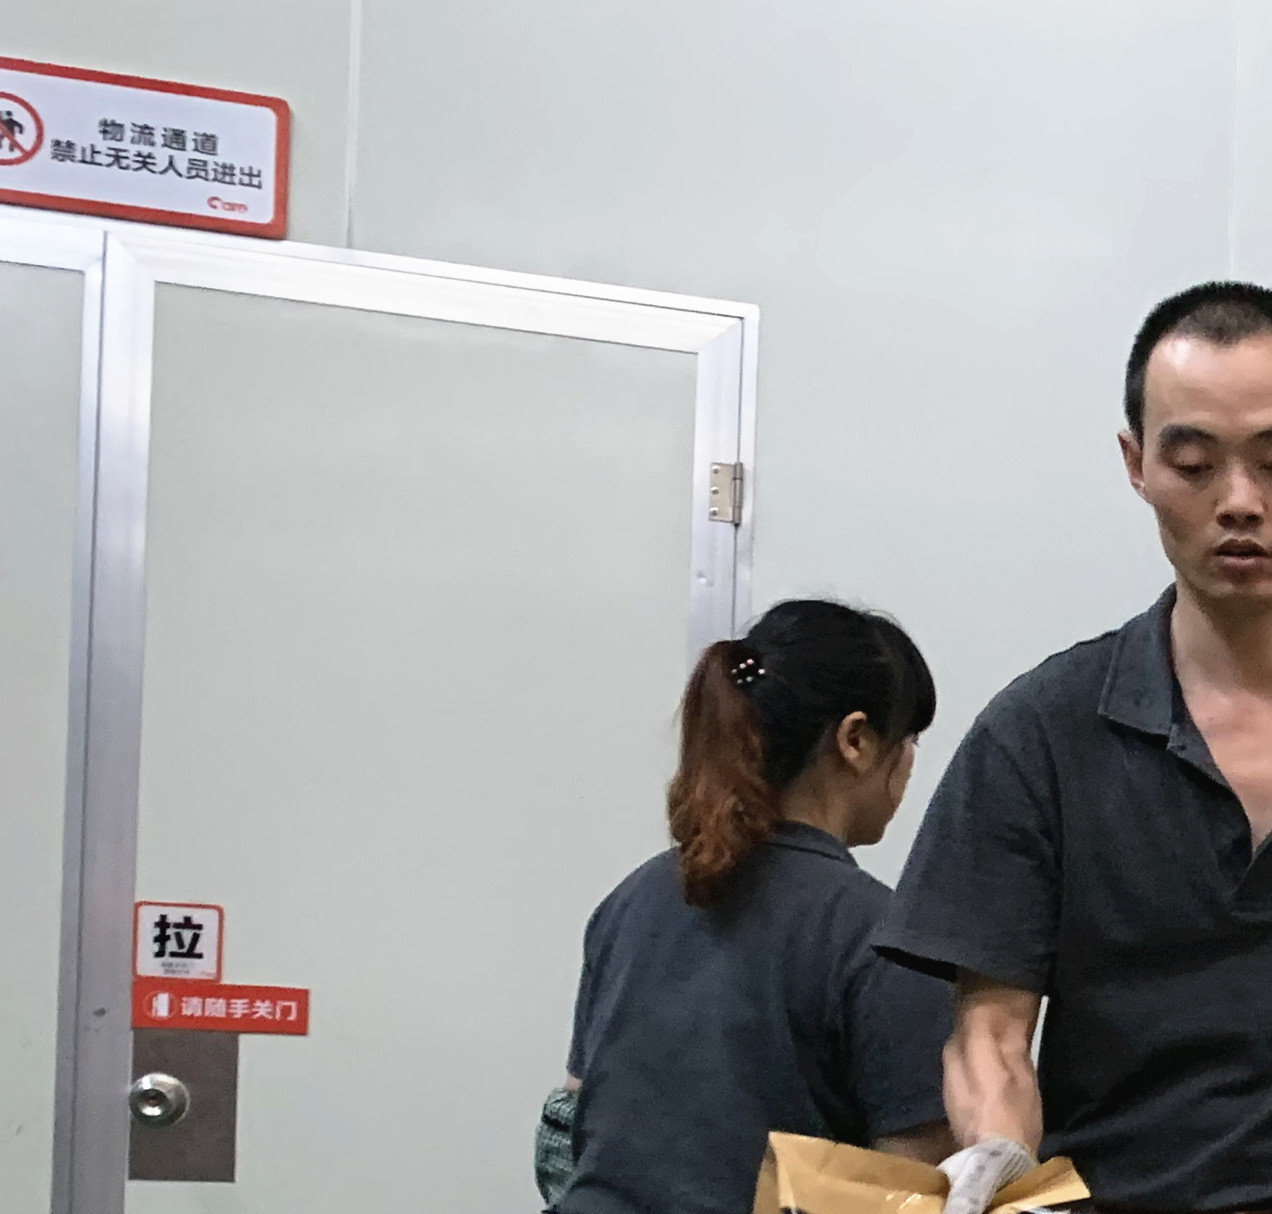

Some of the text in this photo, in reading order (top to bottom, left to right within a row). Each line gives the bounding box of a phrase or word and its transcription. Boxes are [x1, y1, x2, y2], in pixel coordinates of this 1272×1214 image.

[98, 116, 220, 157] 物流通道
[49, 138, 264, 191] 禁止无关人员进出
[152, 914, 205, 960] 拉
[180, 995, 299, 1022] 请随手关门
